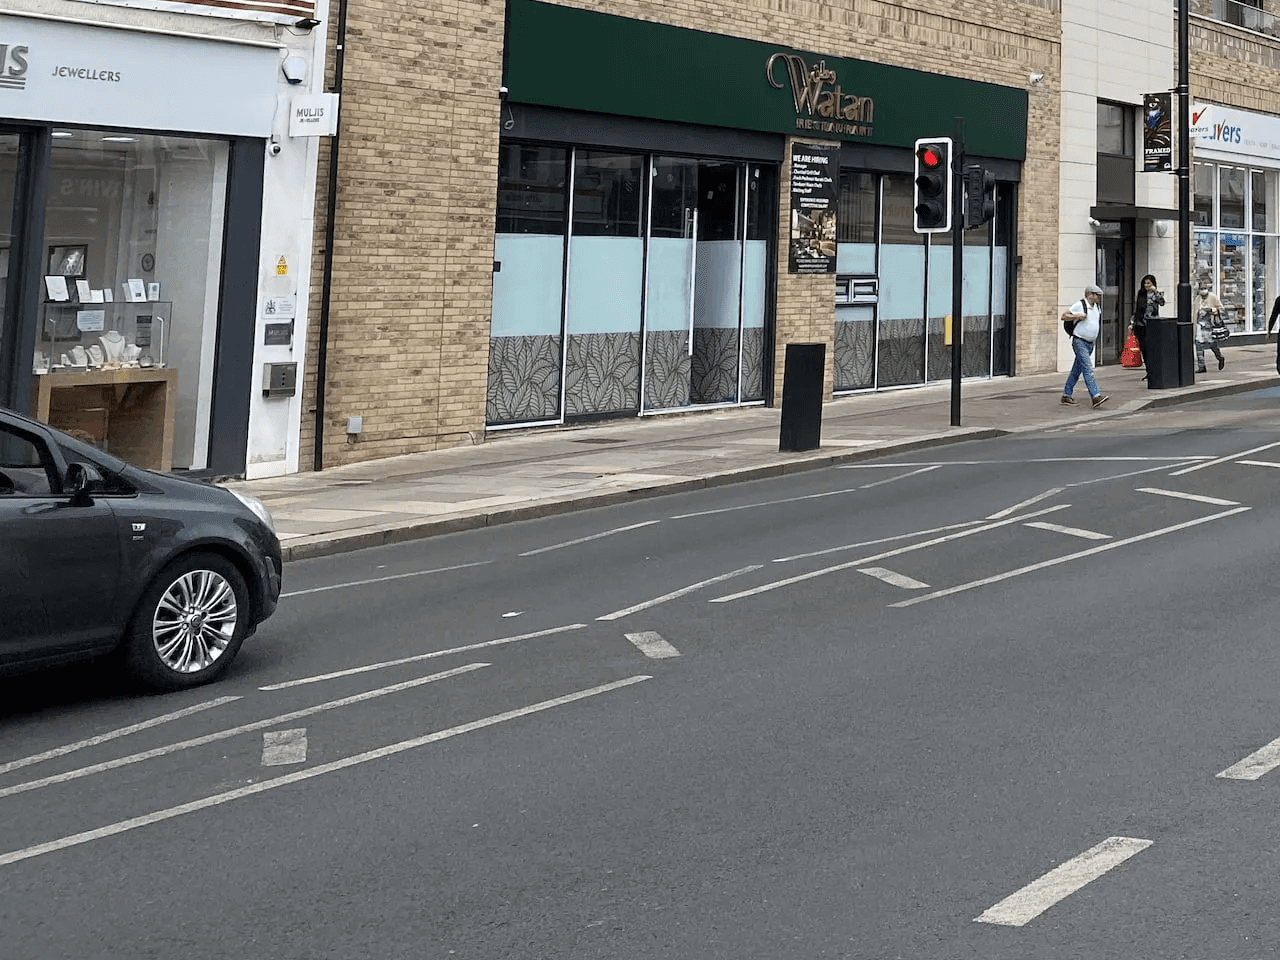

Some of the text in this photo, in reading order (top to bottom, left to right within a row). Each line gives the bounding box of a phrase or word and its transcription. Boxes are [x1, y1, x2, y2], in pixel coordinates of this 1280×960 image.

[52, 66, 121, 82] JEWELLERS
[766, 52, 874, 122] Watan
[297, 107, 324, 117] MULJIS
[796, 118, 874, 136] RESTAURANT
[1202, 120, 1241, 144] avers
